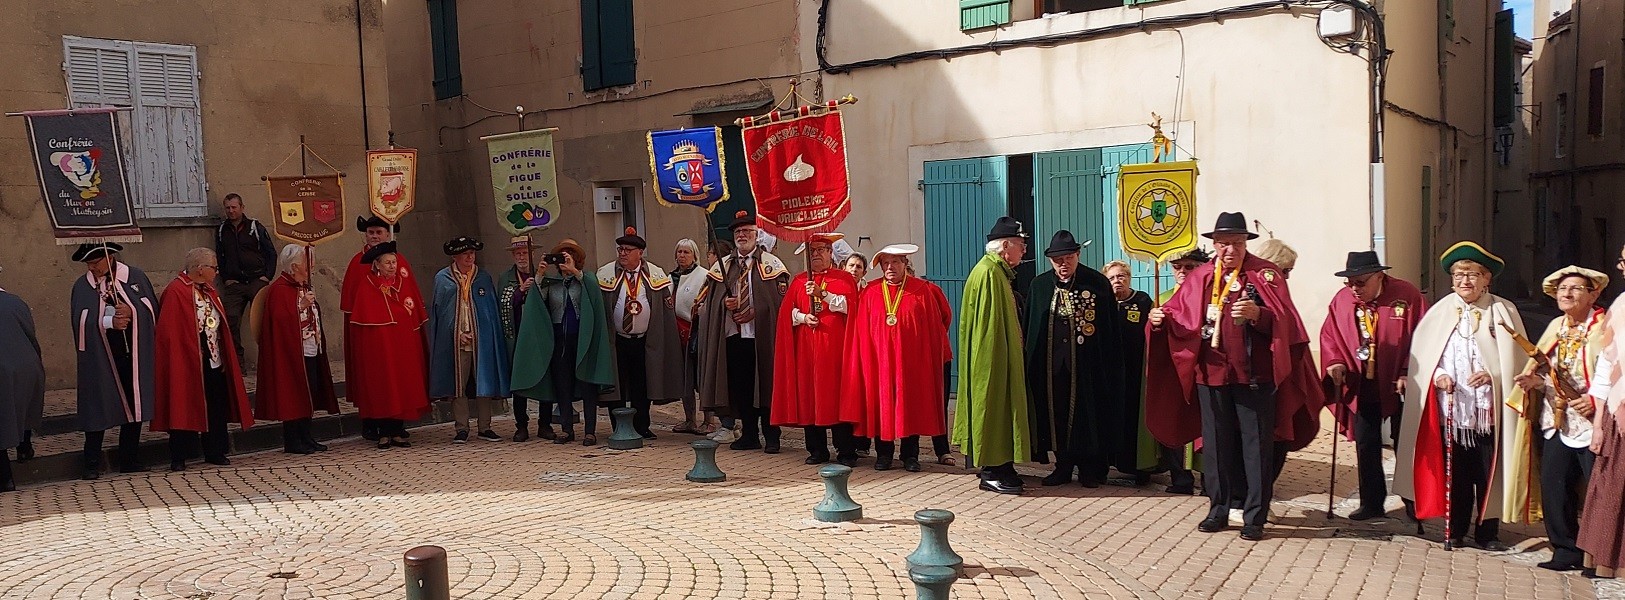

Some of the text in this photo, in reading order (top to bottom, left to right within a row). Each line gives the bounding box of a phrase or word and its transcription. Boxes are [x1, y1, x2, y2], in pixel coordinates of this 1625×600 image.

[48, 137, 94, 150] Confrérie
[492, 147, 552, 164] CONFRÉRIE
[508, 172, 541, 183] FIGUE
[58, 190, 71, 198] du
[506, 190, 549, 202] SOLLIES
[777, 208, 830, 224] VAUCLUSE
